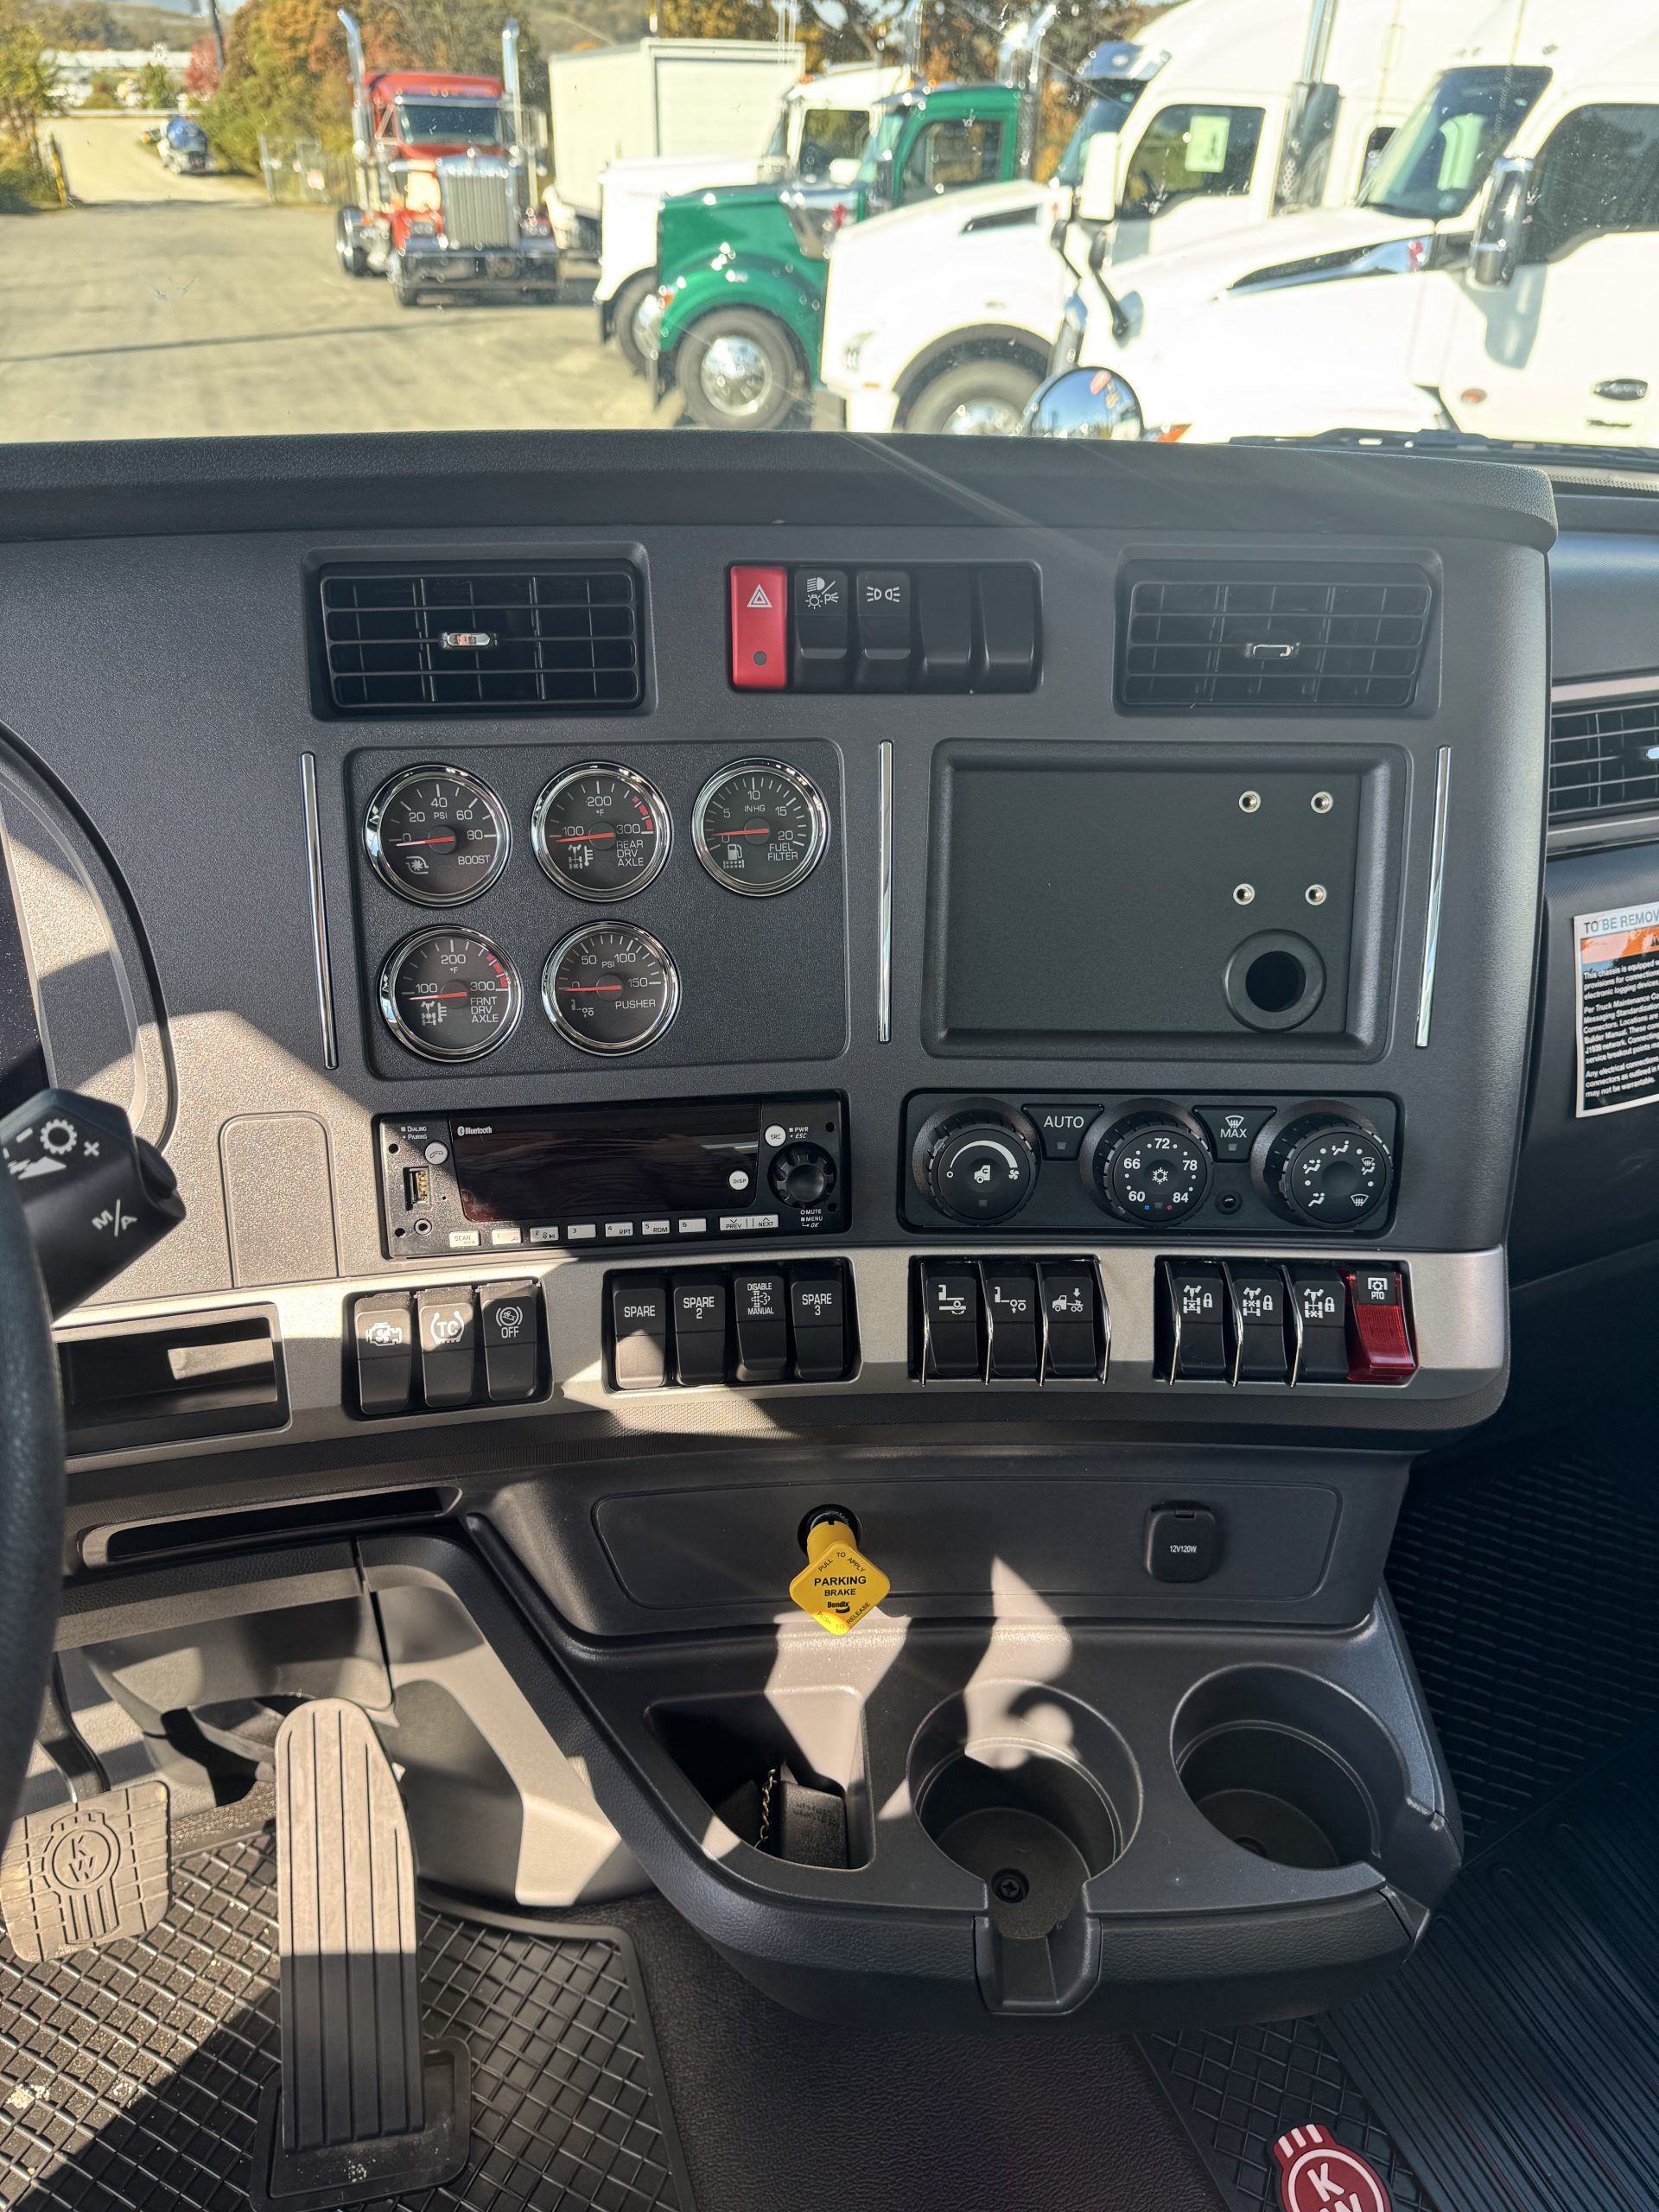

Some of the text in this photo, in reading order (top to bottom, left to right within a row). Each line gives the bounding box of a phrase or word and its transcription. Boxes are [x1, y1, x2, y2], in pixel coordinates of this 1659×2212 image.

[747, 790, 760, 801] 10
[430, 798, 448, 808] 40
[587, 796, 612, 807] 200
[456, 810, 474, 821] 60
[723, 808, 731, 818] 5
[775, 805, 787, 817] 15
[409, 812, 425, 823] 20
[563, 826, 584, 836] 100
[616, 823, 641, 835] 300
[402, 833, 411, 842] 0
[467, 830, 483, 840] 80
[778, 830, 794, 841] 20
[616, 840, 644, 849] REAR
[769, 842, 794, 852] FUEL
[617, 849, 639, 858] DRV
[767, 852, 798, 861] FILTER
[458, 855, 491, 865] BOOST
[618, 857, 644, 867] AXLE
[1583, 920, 1599, 933] TO
[1602, 917, 1618, 931] BE
[441, 954, 467, 964] 200
[582, 955, 597, 965] 50
[614, 952, 636, 963] 100
[1583, 971, 1598, 981] This
[1628, 959, 1655, 972] equipped
[470, 981, 495, 992] 300
[627, 977, 647, 988] 150
[1583, 978, 1615, 991] provisions
[1615, 976, 1624, 984] for
[416, 983, 437, 994] 100
[1584, 988, 1613, 1001] electronic
[1614, 983, 1637, 995] logging
[470, 996, 498, 1006] FRNT
[615, 1000, 656, 1009] PUSHER
[1584, 1006, 1595, 1014] Per
[1595, 1002, 1612, 1012] Truck
[1612, 995, 1651, 1008] Maintenance
[471, 1006, 493, 1014] DRV
[471, 1014, 499, 1023] AXLE
[1629, 1025, 1647, 1034] These
[1586, 1054, 1607, 1065] service
[1606, 1047, 1632, 1059] breakout
[1632, 1044, 1651, 1055] points
[1599, 1062, 1625, 1076] electrical
[1586, 1075, 1621, 1088] connectors
[1629, 1065, 1651, 1078] outlined
[1600, 1086, 1612, 1095] not
[1612, 1084, 1621, 1093] be
[1044, 1116, 1085, 1129] AUTO
[465, 1126, 493, 1135] Bluetooth
[1220, 1128, 1248, 1139] MAX
[1154, 1137, 1171, 1150] 72
[1123, 1158, 1141, 1170] 66
[1182, 1160, 1198, 1172] 78
[1128, 1191, 1146, 1204] 60
[1173, 1192, 1189, 1204] 84
[92, 1199, 137, 1237] M/A
[747, 1282, 772, 1292] DISABLE
[802, 1294, 832, 1306] SPARE
[1371, 1291, 1385, 1300] PTO
[683, 1296, 715, 1309] SPARE
[624, 1306, 656, 1318] SPARE
[696, 1308, 702, 1319] 2
[747, 1306, 774, 1316] MANUAL
[815, 1306, 822, 1316] 3
[436, 1321, 459, 1338] TC
[500, 1326, 519, 1338] OFF
[1169, 1545, 1197, 1554] 12V120W
[818, 1558, 834, 1573] PULL
[847, 1557, 866, 1573] APPLY
[814, 1575, 867, 1586] PARKING
[824, 1588, 856, 1597] BRAKE
[846, 1601, 871, 1624] RELEASE
[72, 1835, 89, 1859] K
[69, 1857, 97, 1882] W
[1306, 2162, 1344, 2202] K
